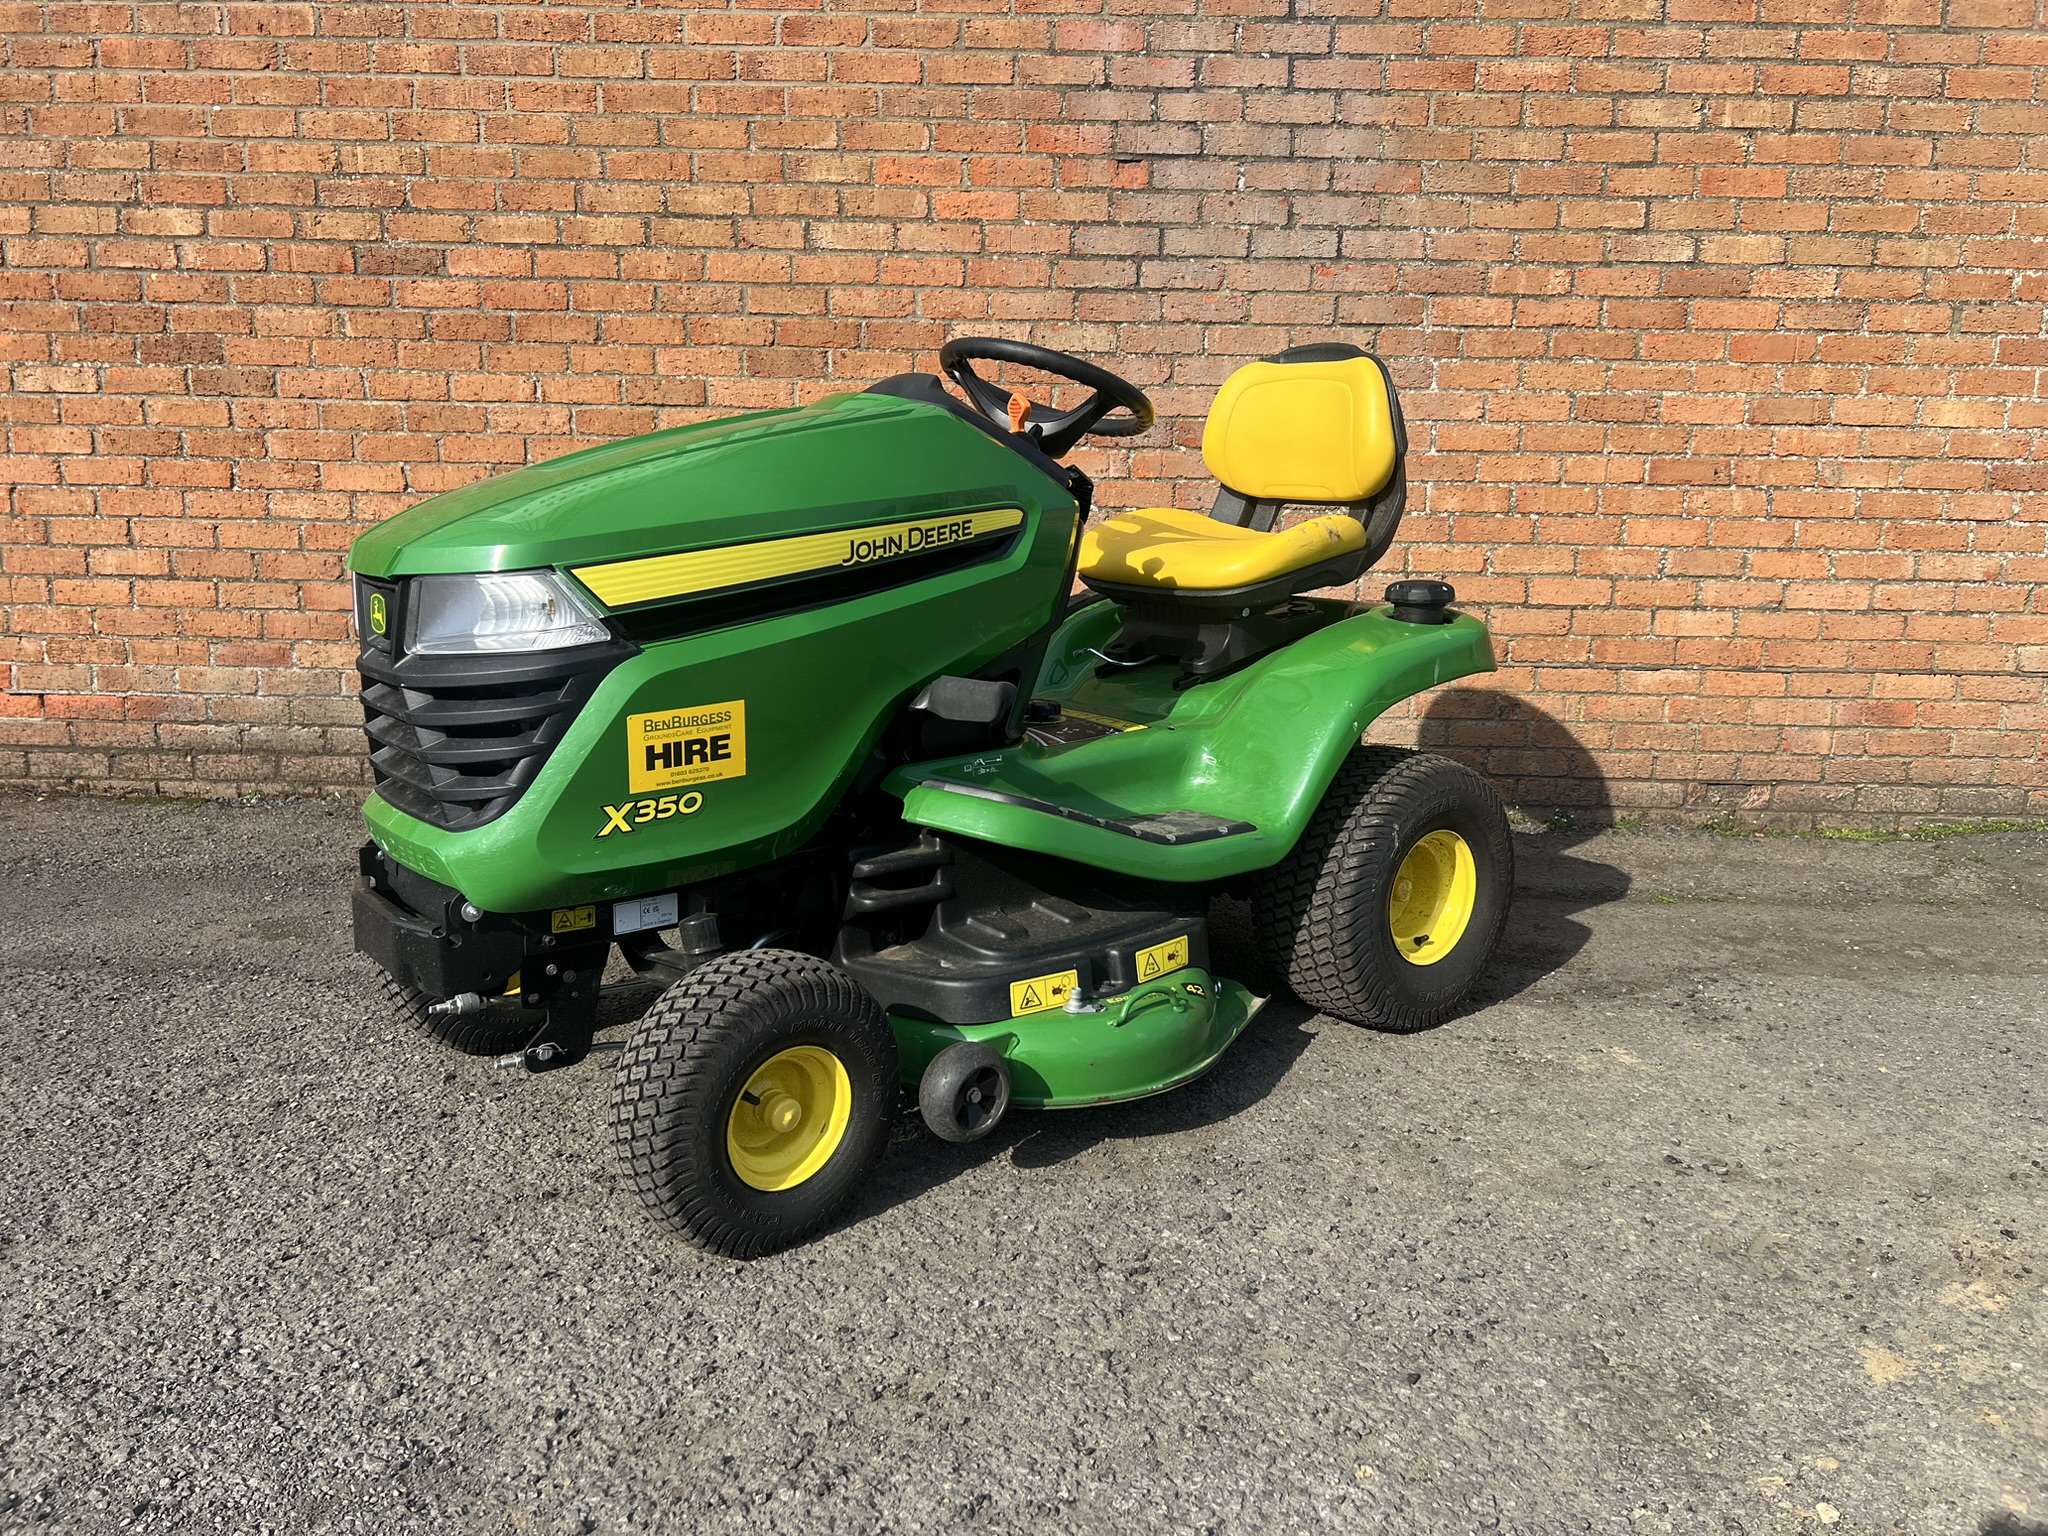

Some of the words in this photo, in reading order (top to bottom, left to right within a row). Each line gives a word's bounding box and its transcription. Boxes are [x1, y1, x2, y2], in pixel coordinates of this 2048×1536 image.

[842, 534, 904, 565] JOHN
[908, 519, 974, 551] DEERE
[646, 734, 732, 771] HIRE
[595, 790, 705, 838] X350
[1186, 984, 1205, 996] 42
